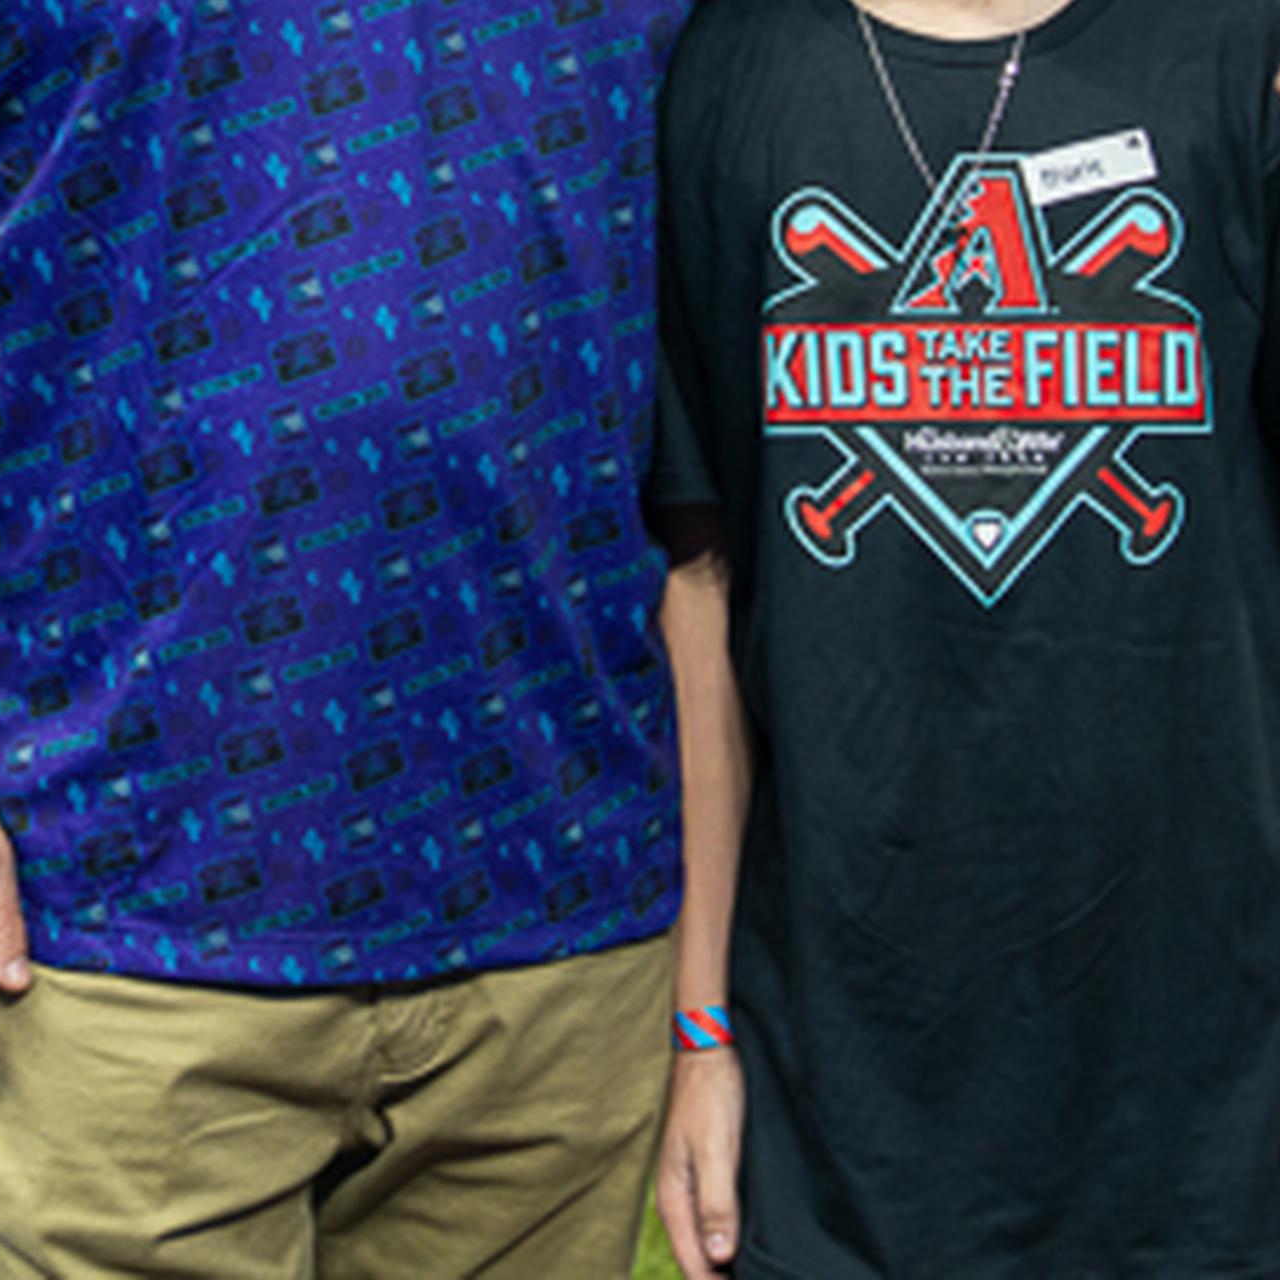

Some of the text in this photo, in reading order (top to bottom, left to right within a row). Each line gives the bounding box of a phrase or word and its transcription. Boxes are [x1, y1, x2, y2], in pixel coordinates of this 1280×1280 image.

[765, 330, 909, 409] KIDS
[919, 330, 1012, 361] TAKE
[1024, 330, 1199, 409] FIELD
[921, 366, 1013, 408] THE
